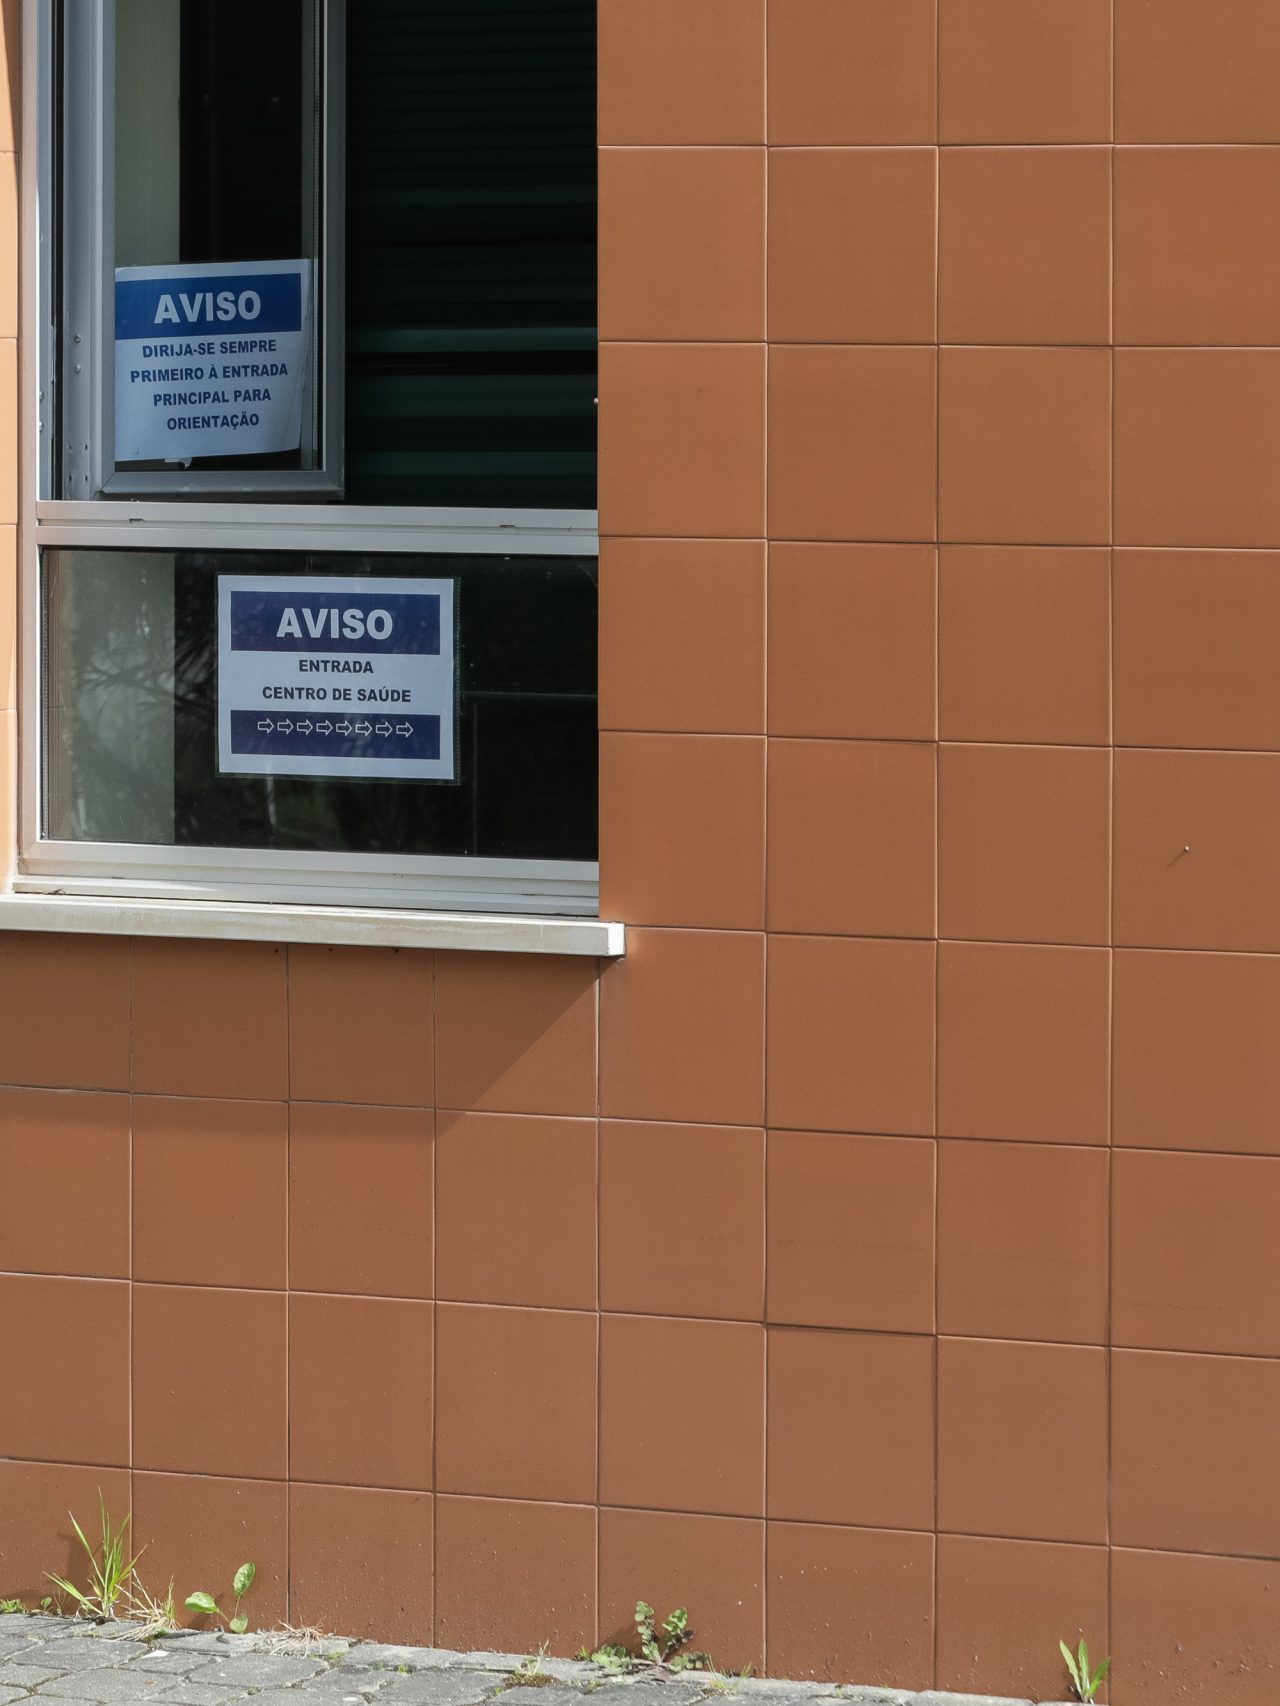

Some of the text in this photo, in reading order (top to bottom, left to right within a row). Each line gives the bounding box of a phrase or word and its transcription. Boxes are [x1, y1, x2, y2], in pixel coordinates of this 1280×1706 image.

[153, 290, 261, 324] AVISO
[142, 339, 277, 358] DIRIJA-SE SEMPRE
[130, 363, 289, 383] PRIMEIRO À ENTRADA
[153, 388, 272, 407] PRINCIPAL PARA
[166, 411, 260, 431] ORIENTAÇÃO
[276, 607, 393, 640] AVISO
[298, 659, 375, 674] ENTRADA
[262, 686, 412, 703] CENTRO DE SAÚDE
